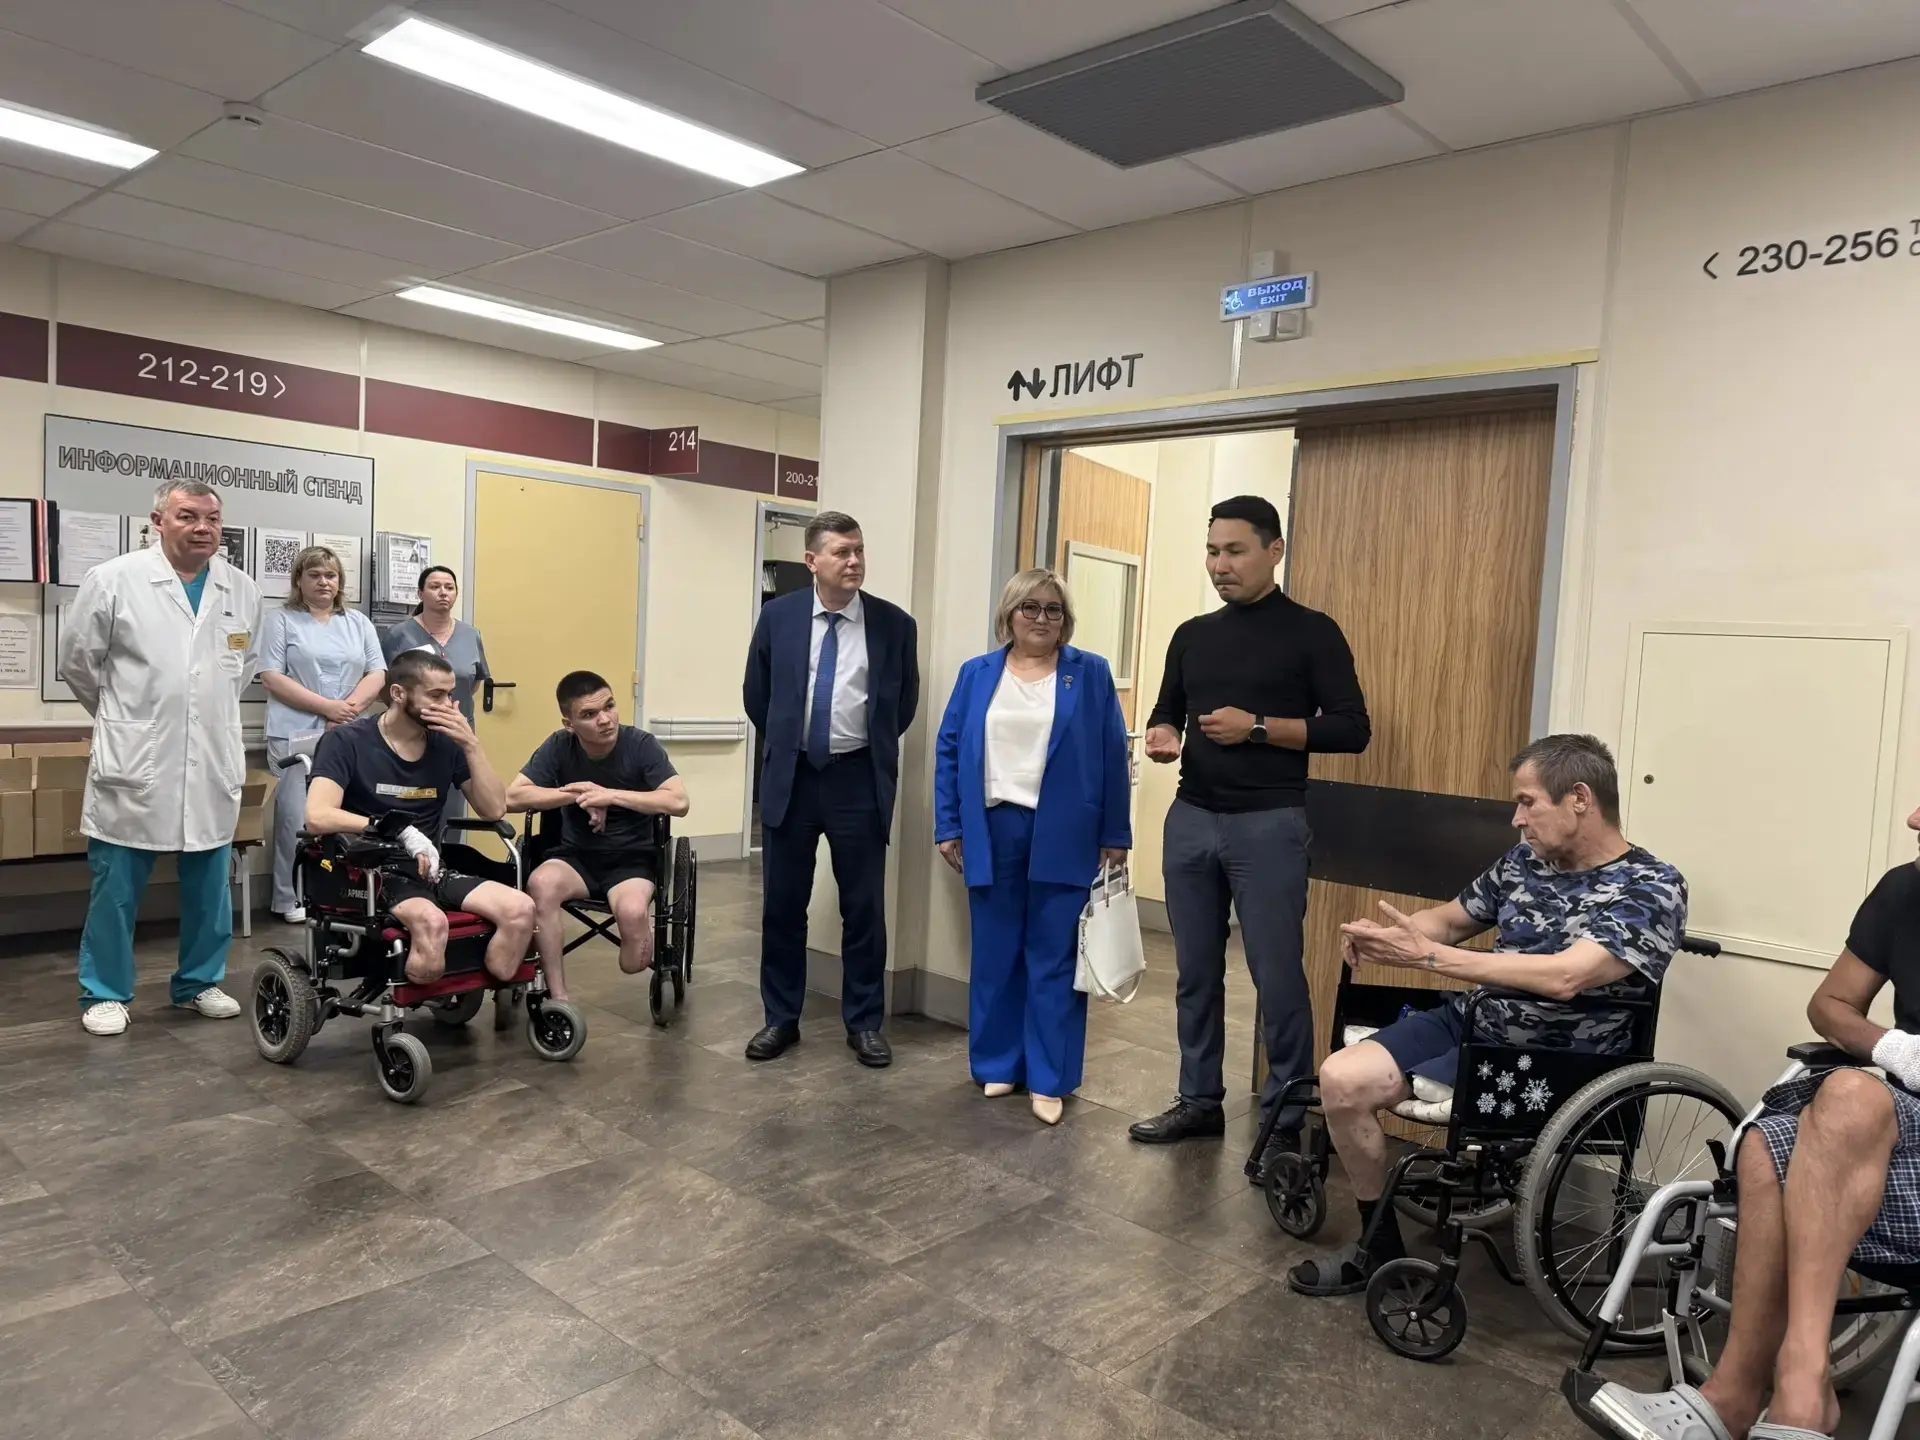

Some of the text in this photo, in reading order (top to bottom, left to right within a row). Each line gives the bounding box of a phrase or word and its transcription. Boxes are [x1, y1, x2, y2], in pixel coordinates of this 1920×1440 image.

[1736, 227, 1898, 277] 230-256
[1247, 279, 1304, 297] ВЫХОД
[1260, 293, 1288, 305] EXIT
[137, 352, 268, 396] 212-219
[1049, 353, 1144, 398] ЛИФТ
[668, 429, 697, 452] 214
[58, 446, 363, 505] ИНФОРМАЦИОННЫЙ СТЕНД
